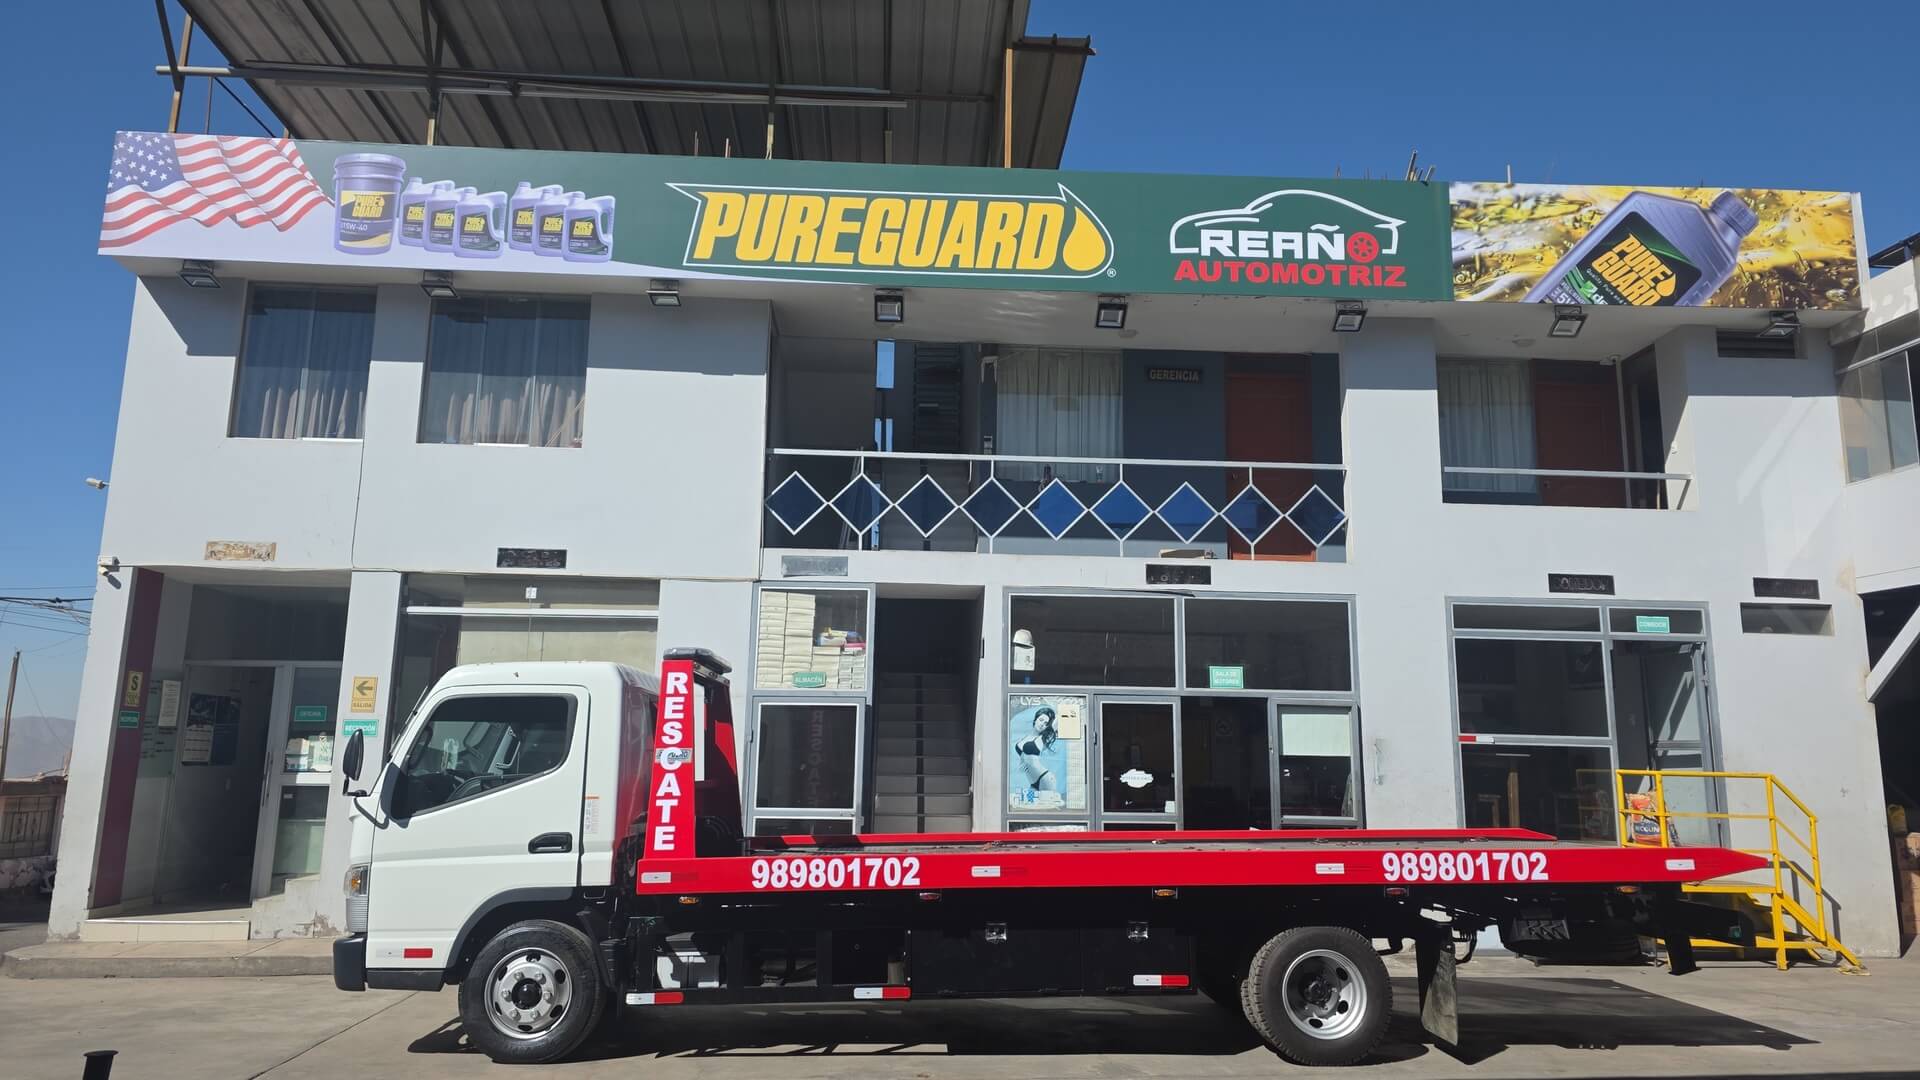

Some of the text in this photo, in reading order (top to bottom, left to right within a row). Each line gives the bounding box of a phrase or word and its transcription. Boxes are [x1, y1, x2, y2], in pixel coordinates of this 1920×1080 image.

[693, 191, 1065, 271] PUREGUARD
[1174, 260, 1407, 287] AUTOMOTRIZ
[1591, 252, 1661, 305] GUARD
[1612, 233, 1673, 287] PURE
[1150, 369, 1200, 381] GERENCIA
[653, 671, 688, 851] RESCATE
[751, 857, 920, 888] 989801702
[1382, 852, 1549, 881] 989801702
